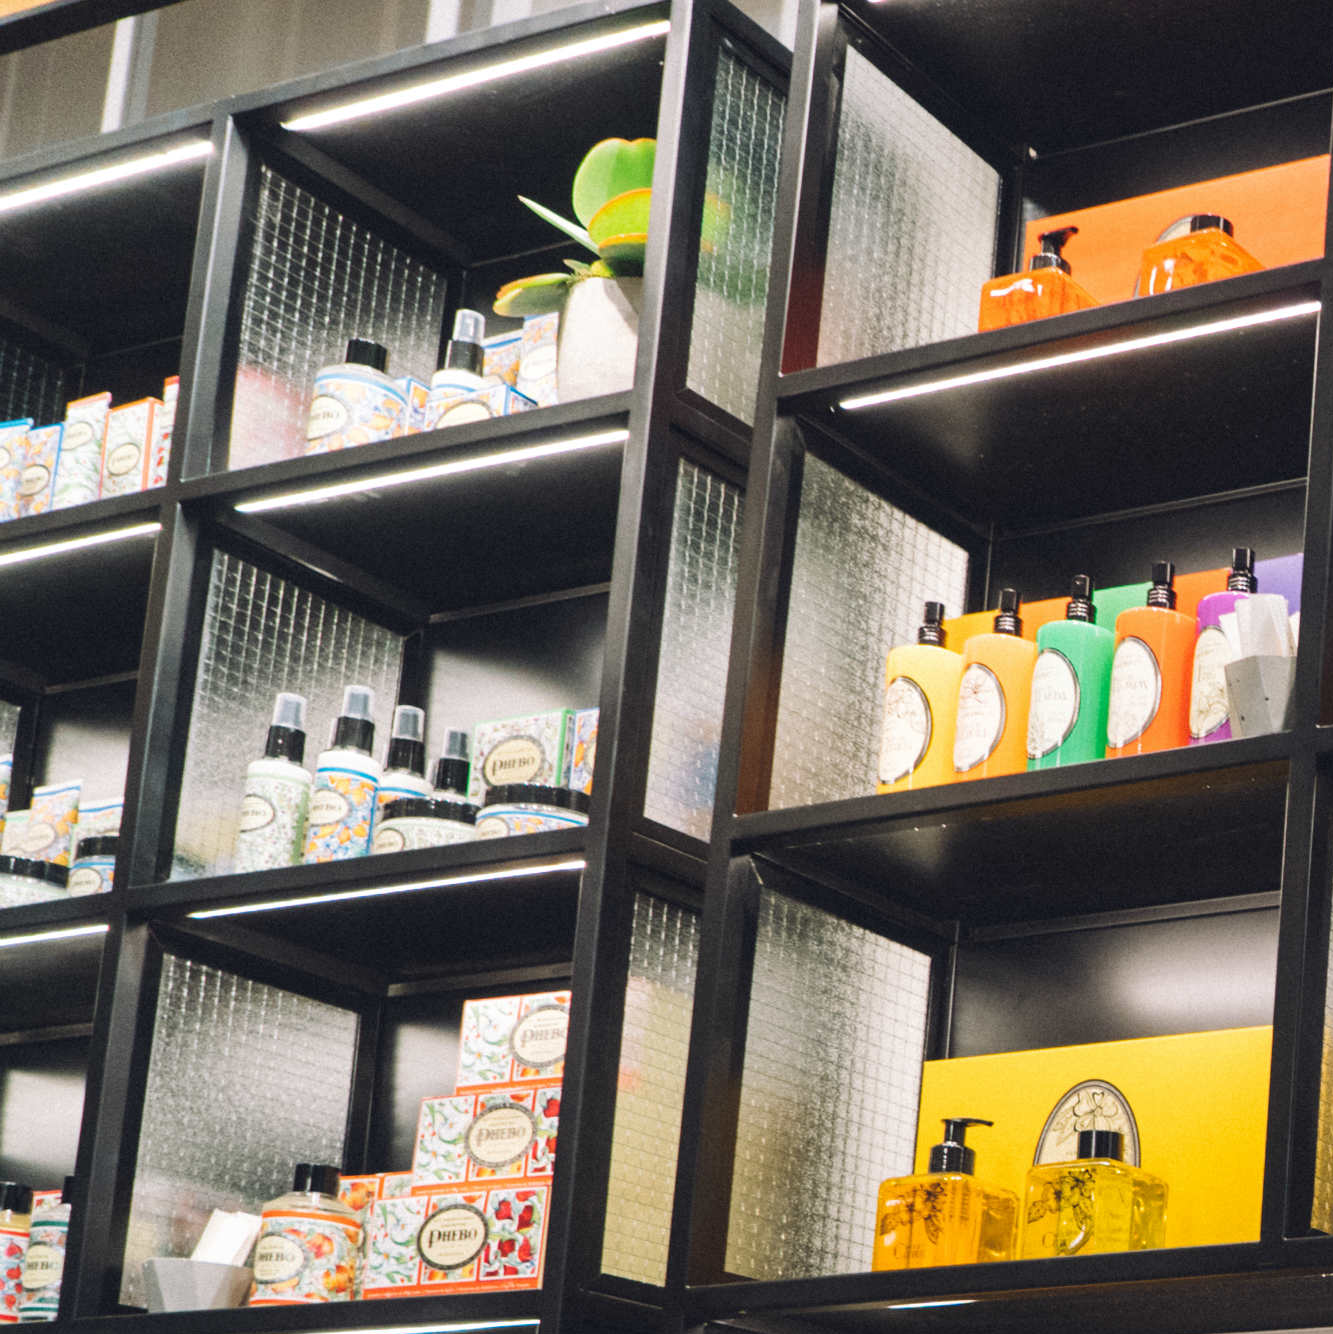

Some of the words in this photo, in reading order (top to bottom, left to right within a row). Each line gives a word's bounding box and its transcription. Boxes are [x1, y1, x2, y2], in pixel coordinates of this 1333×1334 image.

[491, 756, 536, 776] PHEBO
[478, 1126, 527, 1147] PHEBO
[428, 1227, 478, 1249] PHEBO
